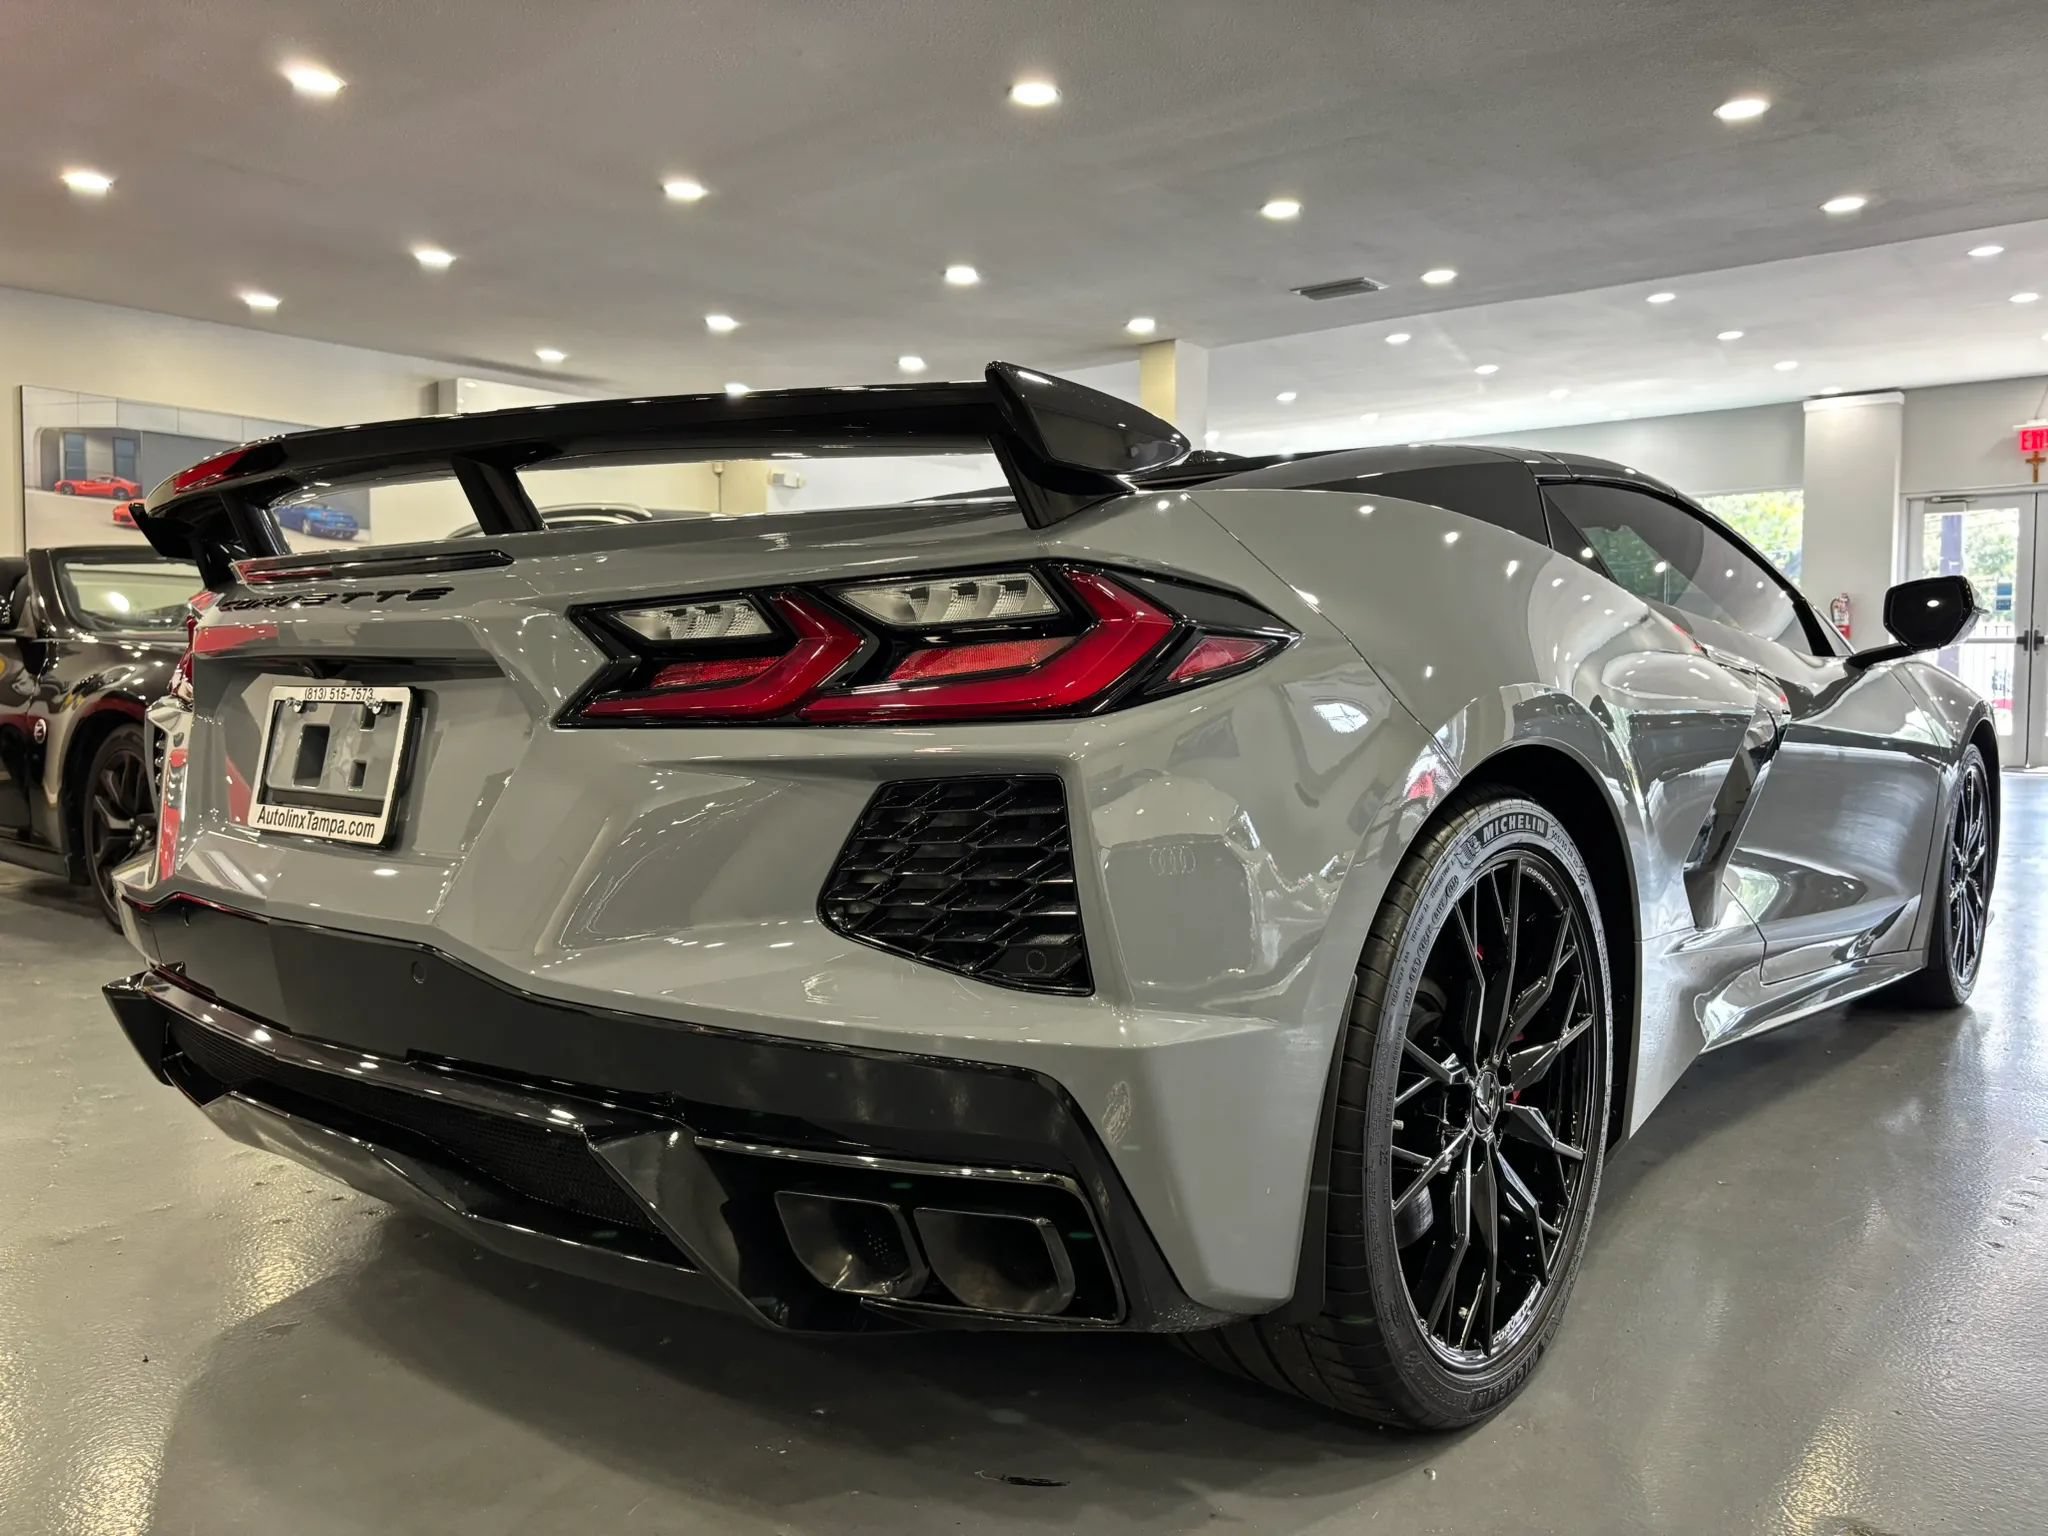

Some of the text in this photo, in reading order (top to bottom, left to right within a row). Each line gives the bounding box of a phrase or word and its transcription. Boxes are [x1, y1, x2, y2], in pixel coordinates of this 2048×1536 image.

[218, 587, 455, 612] CORVETTE
[304, 687, 374, 701] (813) 515-7573
[256, 805, 376, 839] AutolinxTampa.com
[1483, 814, 1546, 843] MICHELIN
[1526, 866, 1558, 897] FORGED
